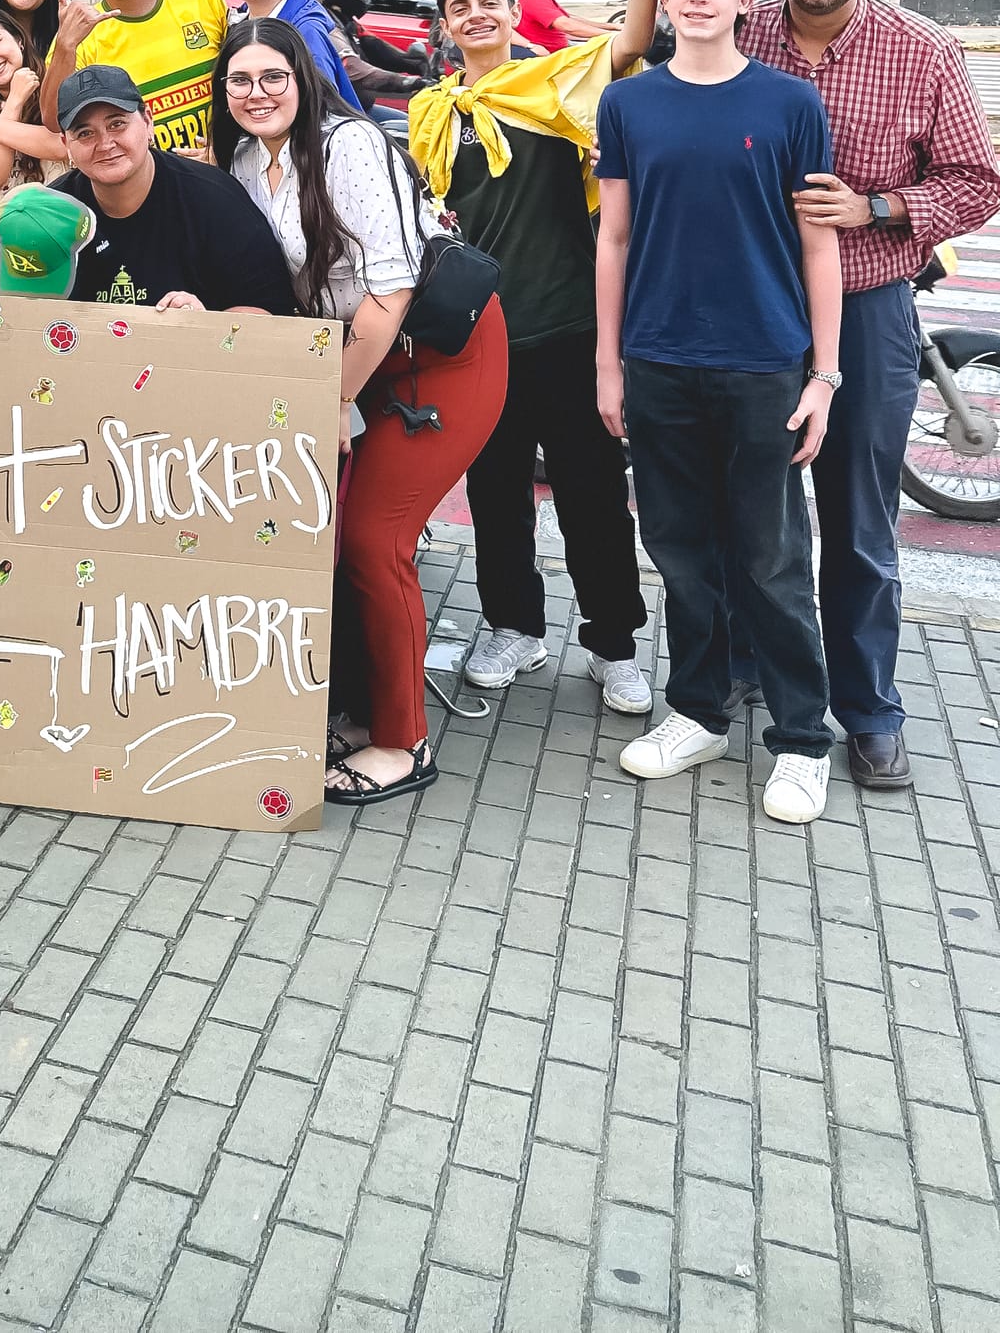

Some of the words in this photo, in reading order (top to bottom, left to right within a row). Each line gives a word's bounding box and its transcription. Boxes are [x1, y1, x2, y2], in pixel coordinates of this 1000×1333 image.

[96, 291, 108, 302] 20
[136, 288, 147, 300] 25
[80, 593, 329, 702] HAMBRE
